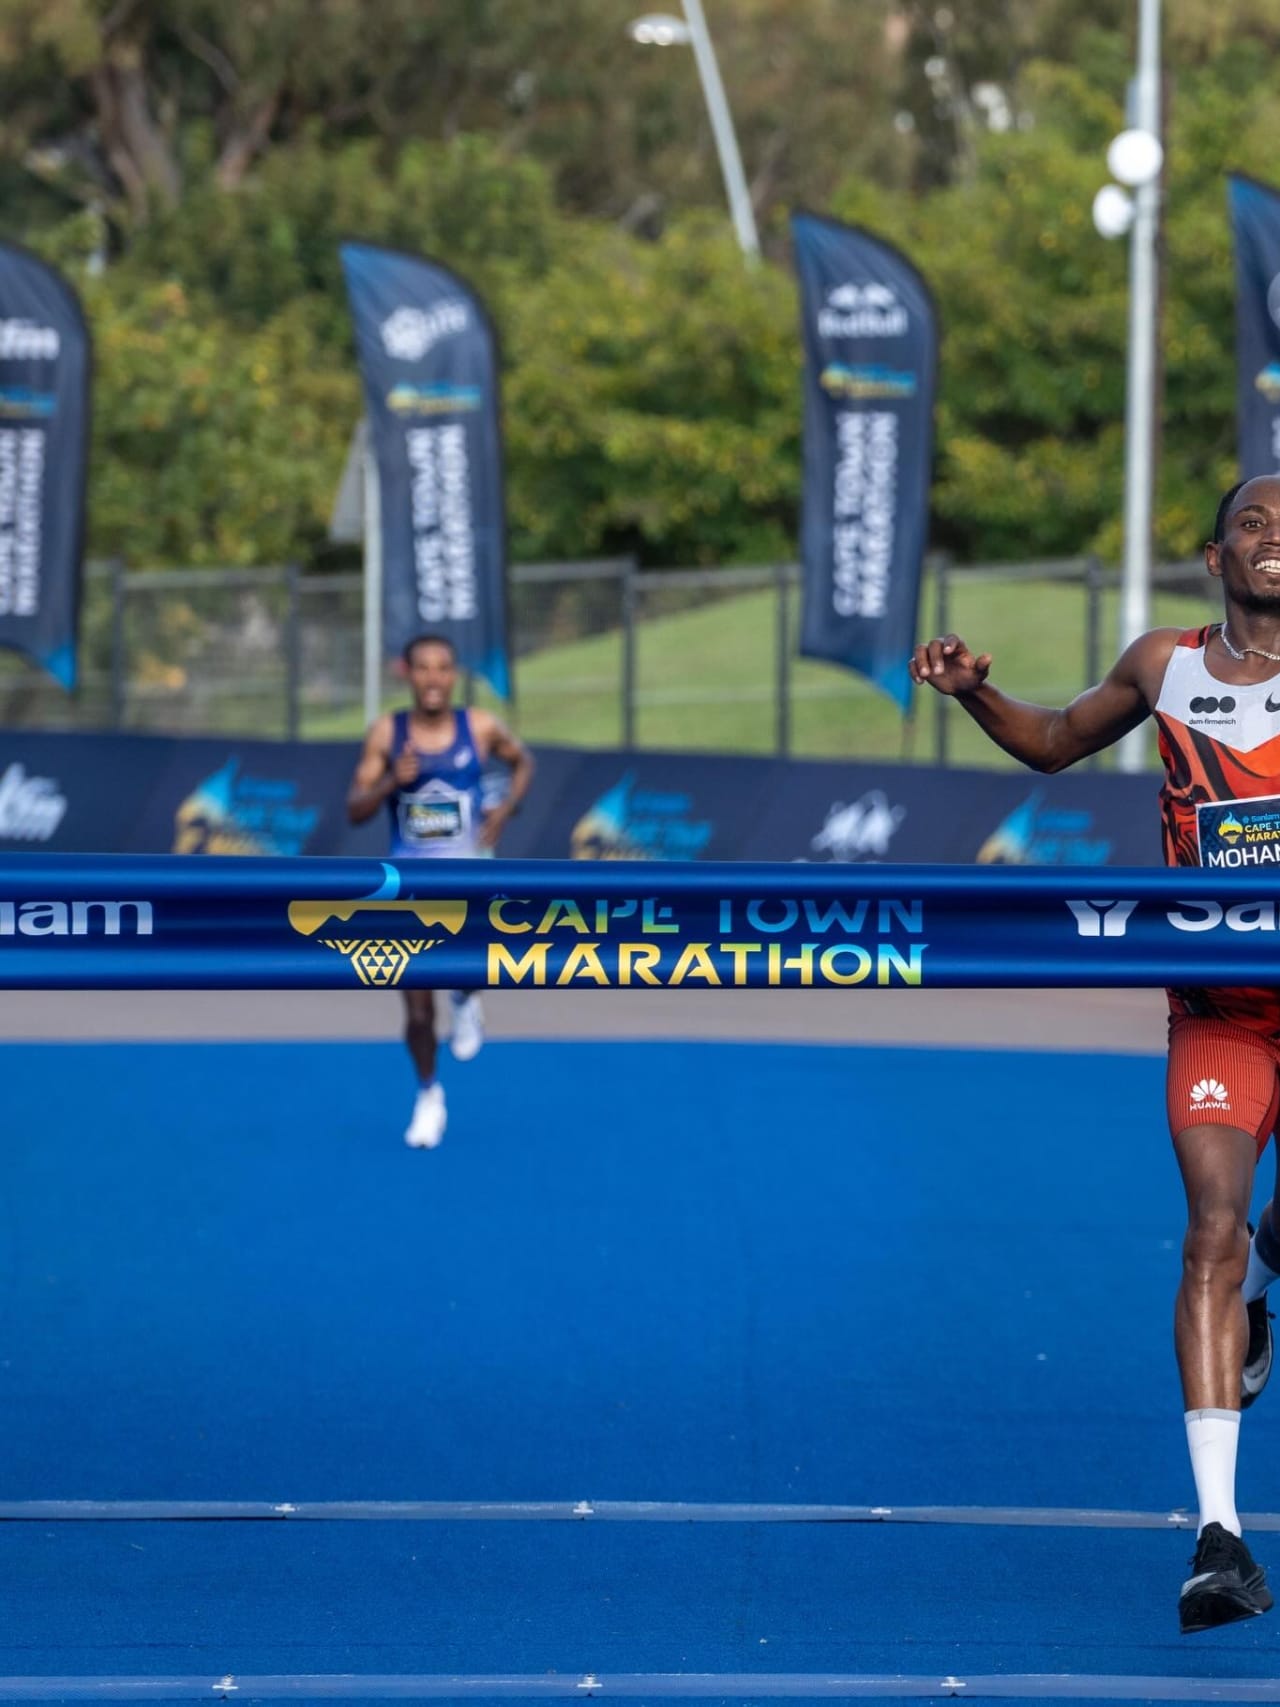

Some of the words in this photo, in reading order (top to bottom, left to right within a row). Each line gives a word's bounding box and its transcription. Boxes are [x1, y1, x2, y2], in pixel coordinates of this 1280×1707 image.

[1251, 812, 1280, 823] Sanlam
[1244, 822, 1273, 833] CAPE
[487, 896, 680, 934] CAPE
[719, 899, 923, 933] TOWN
[487, 943, 930, 986] MARATHON
[1189, 1101, 1231, 1111] HUAWEI
